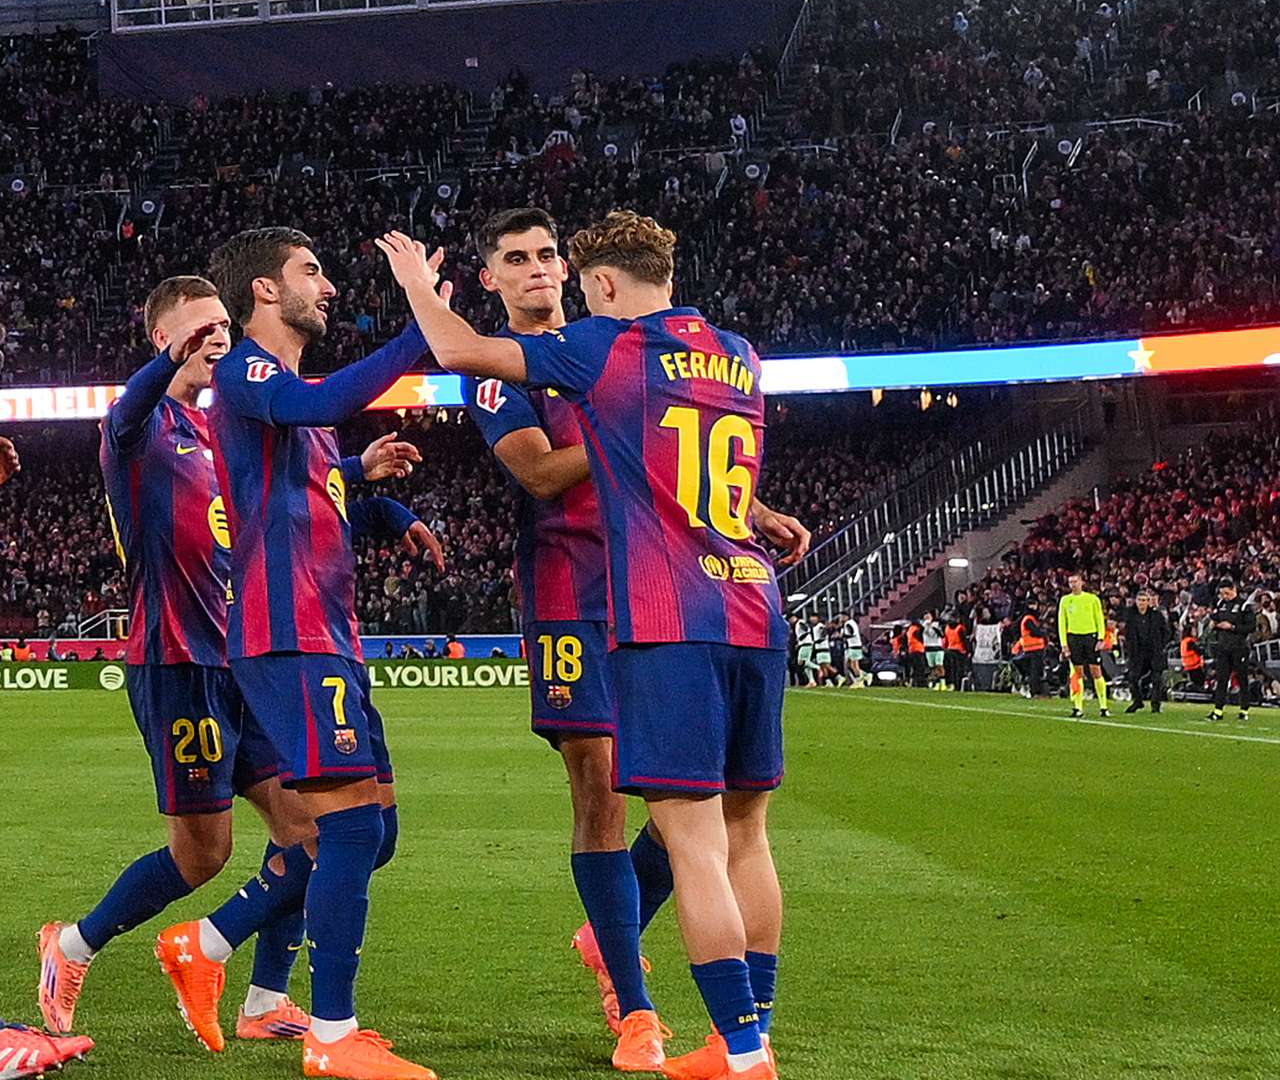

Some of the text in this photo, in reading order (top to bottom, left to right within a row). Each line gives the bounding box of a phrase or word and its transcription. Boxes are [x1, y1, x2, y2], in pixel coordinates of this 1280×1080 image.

[659, 351, 755, 396] FERMÍN
[659, 405, 757, 541] 16
[3, 667, 68, 689] LOVE
[384, 665, 460, 687] YOUR
[462, 665, 529, 687] LOVE
[537, 634, 582, 682] 18
[321, 677, 347, 725] 7
[172, 717, 224, 763] 20
